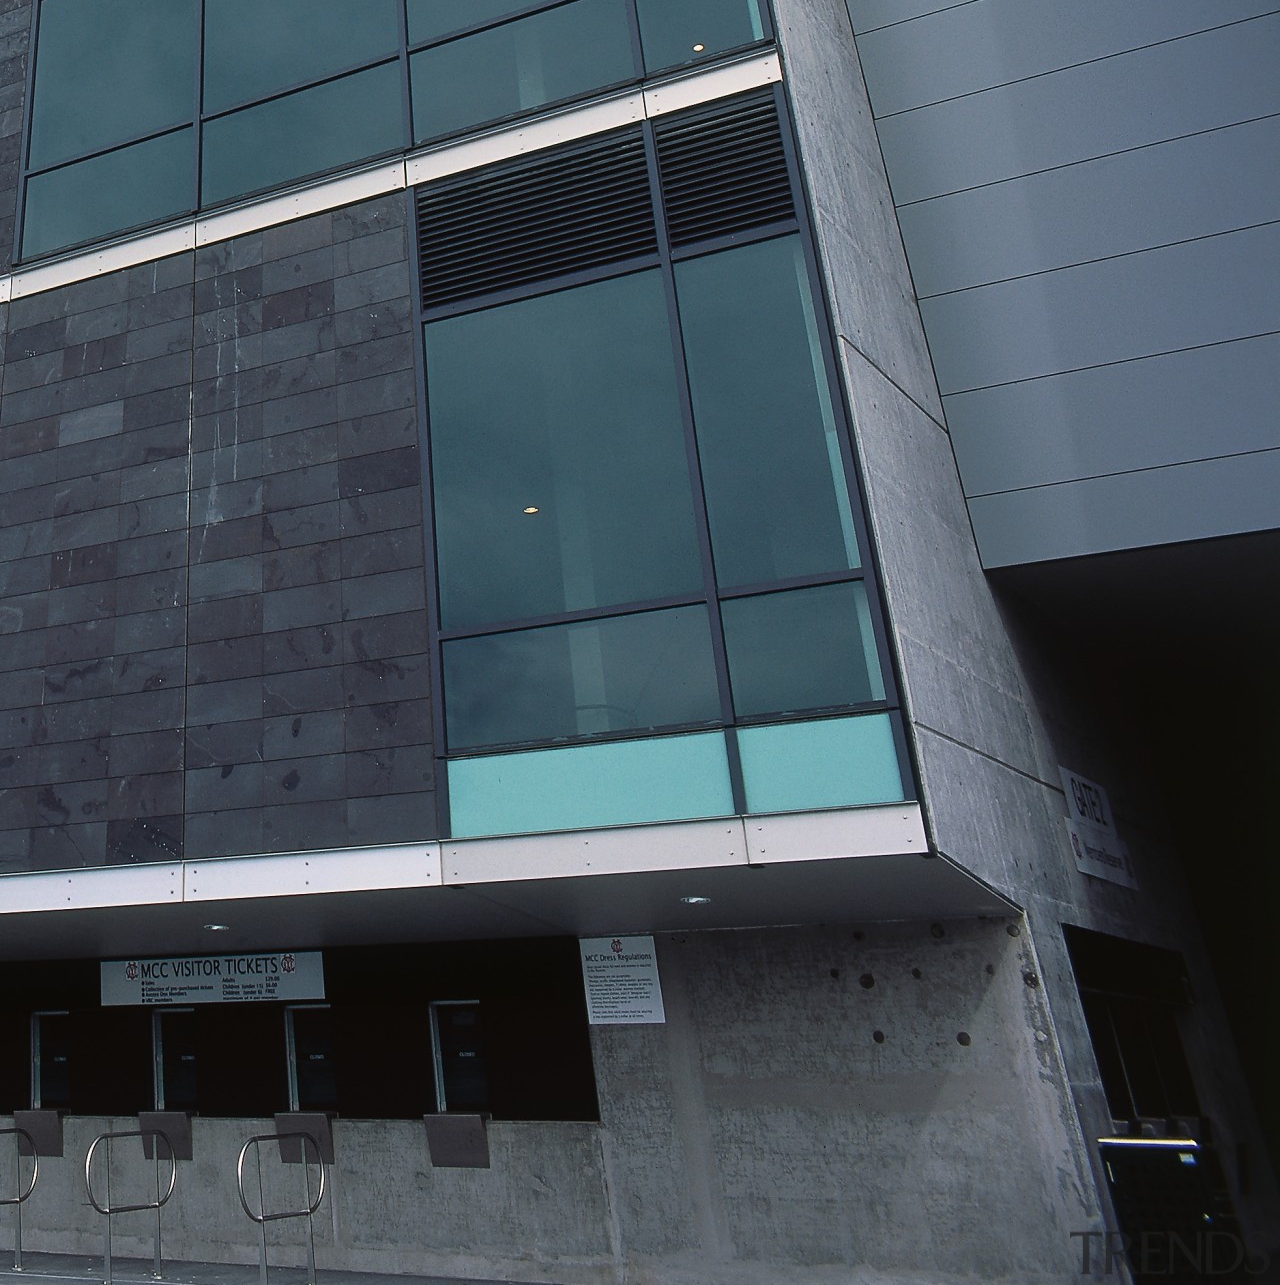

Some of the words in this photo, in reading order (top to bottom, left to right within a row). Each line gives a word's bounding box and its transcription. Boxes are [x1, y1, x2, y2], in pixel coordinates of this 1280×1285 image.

[1071, 777, 1101, 824] GATE
[141, 962, 169, 979] MCC
[171, 960, 221, 977] VISITOR
[225, 957, 278, 975] TICKETS
[585, 954, 598, 962] MCC
[600, 954, 616, 962] Dress
[617, 953, 652, 963] Regulations
